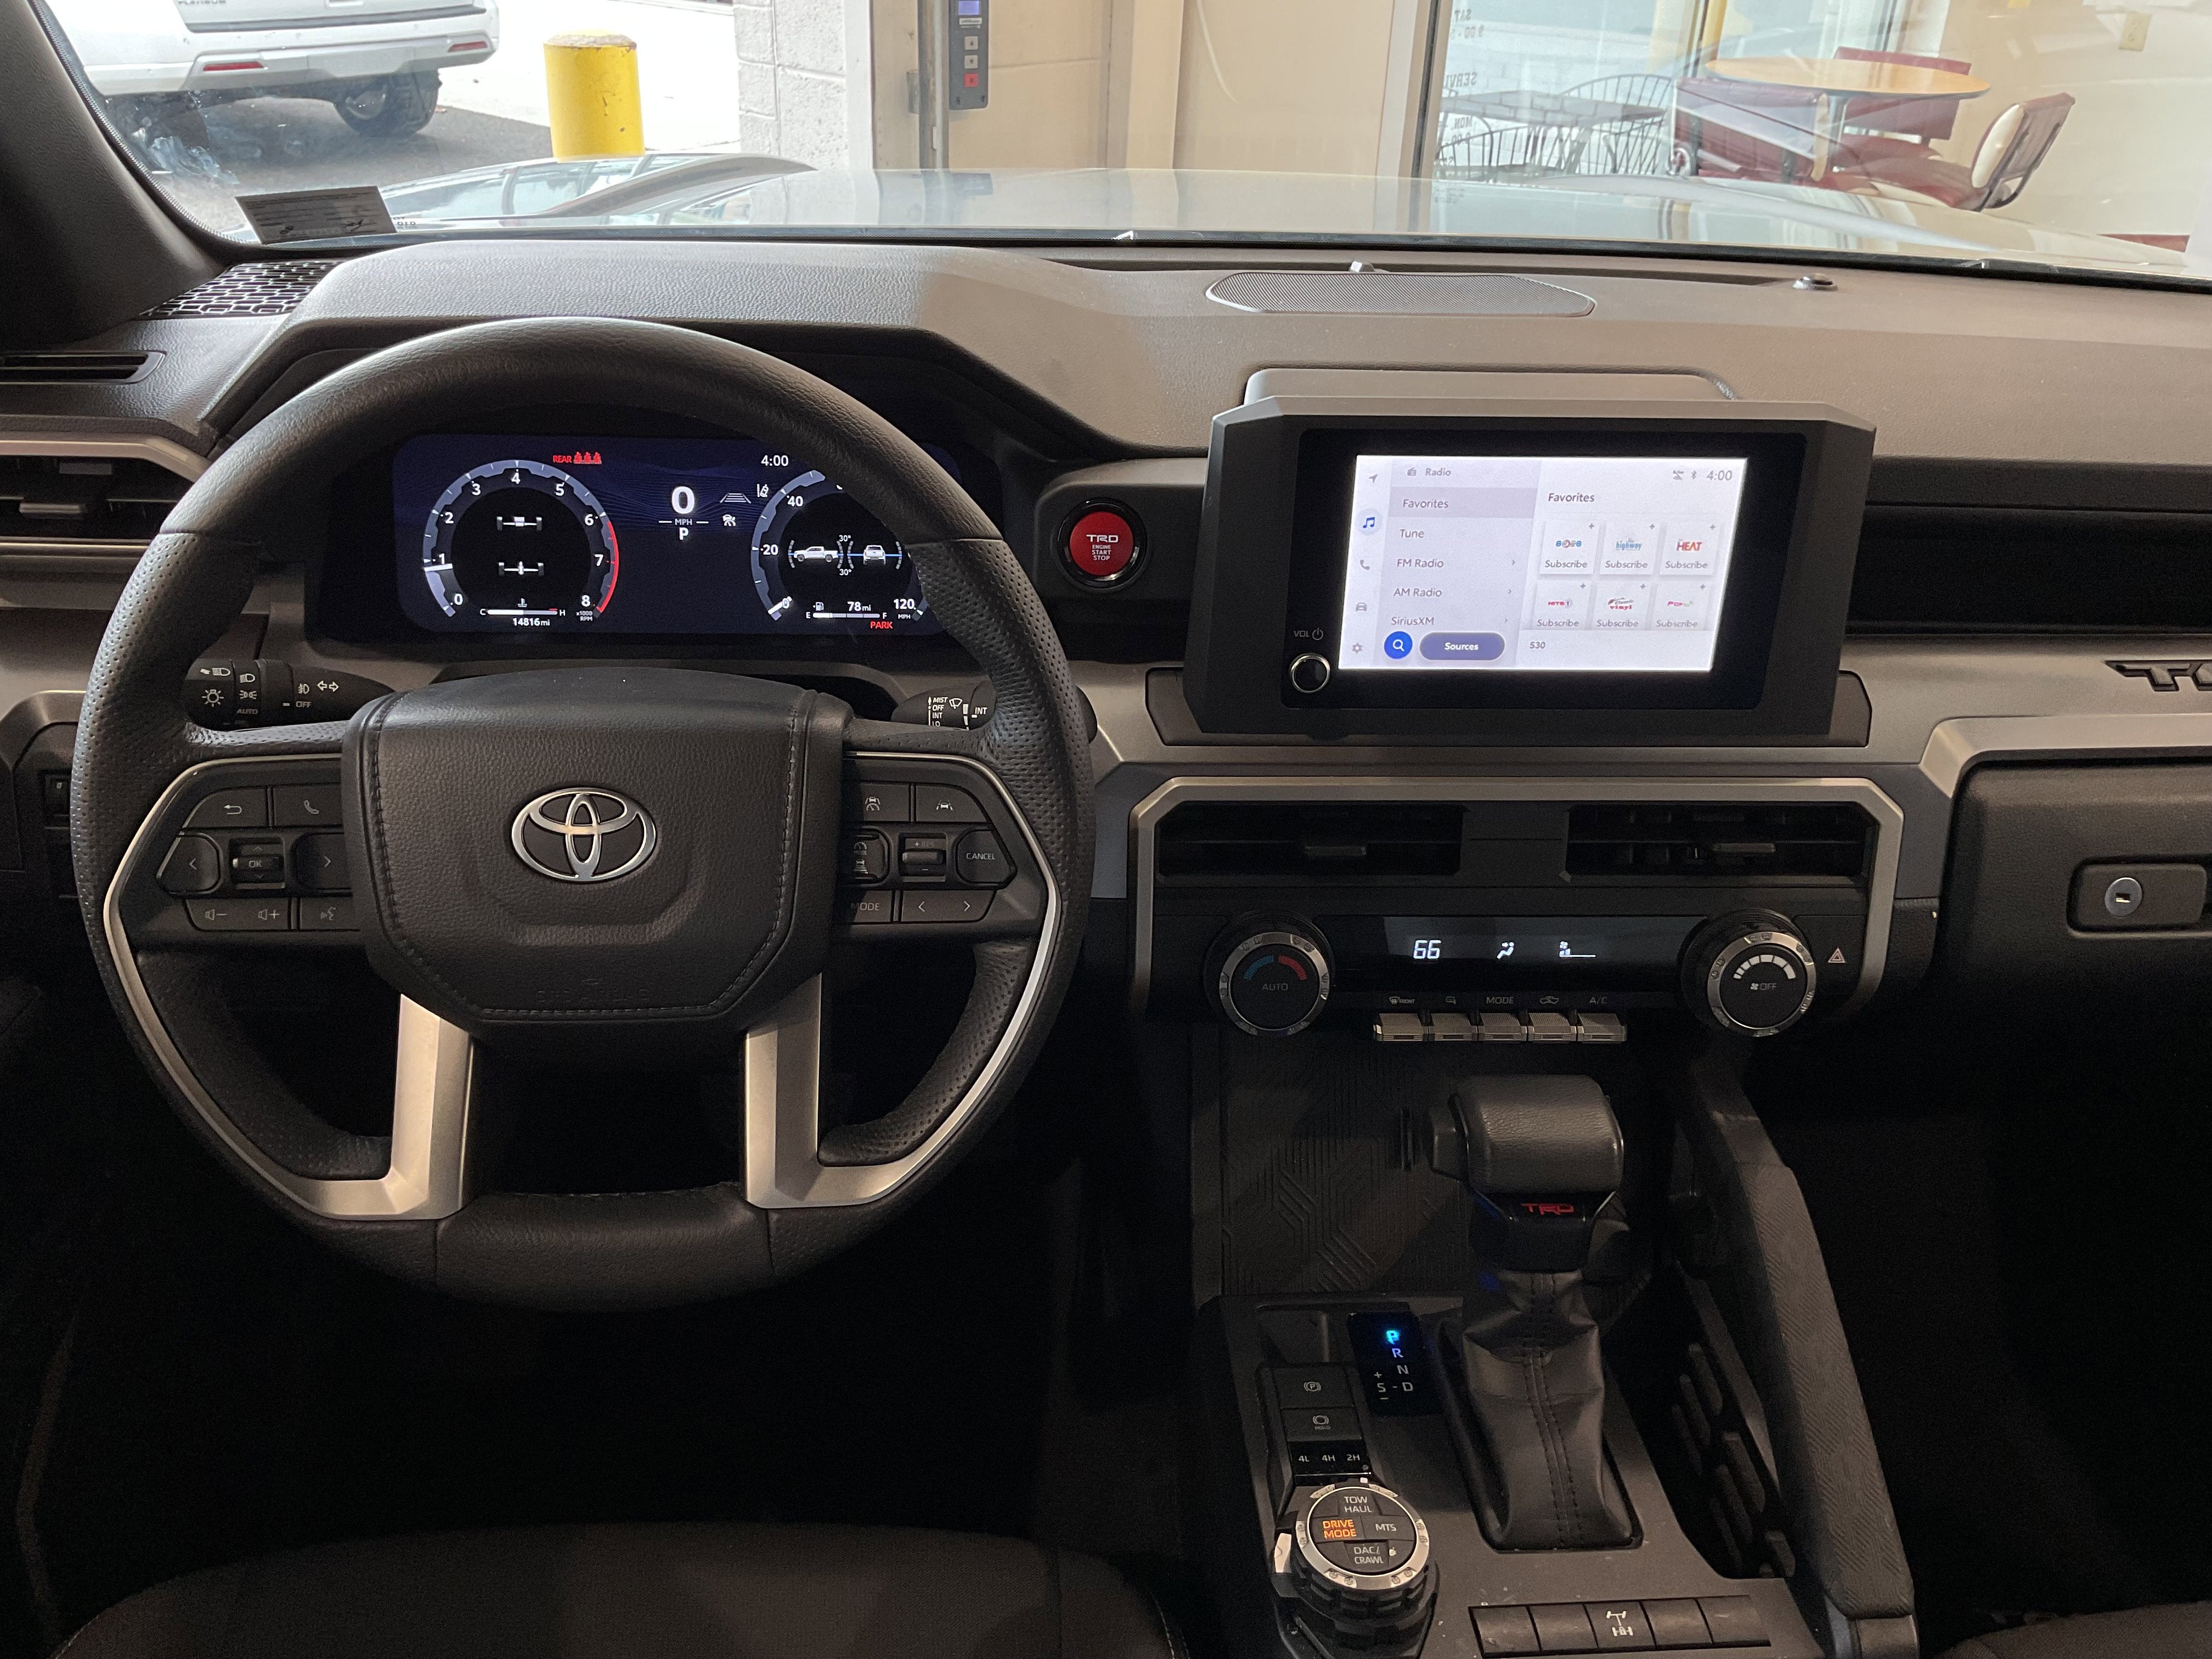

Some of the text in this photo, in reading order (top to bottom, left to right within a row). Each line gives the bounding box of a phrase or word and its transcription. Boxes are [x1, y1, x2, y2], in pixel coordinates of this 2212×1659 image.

[760, 455, 789, 467] 4:00
[1425, 467, 1452, 477] Radio
[1706, 470, 1733, 481] 4:00
[511, 472, 521, 484] 4
[472, 483, 481, 495] 3
[556, 484, 565, 496] 5
[670, 486, 696, 515] 0
[787, 495, 804, 507] 40
[1548, 493, 1595, 503] Favorites
[1402, 499, 1449, 509] Favorites
[444, 512, 454, 524] 2
[584, 514, 594, 526] 6
[679, 527, 689, 540] P
[1400, 528, 1425, 538] Tune
[838, 534, 851, 543] 30°
[1086, 534, 1119, 543] TRD
[763, 544, 778, 555] 20
[1616, 540, 1642, 551] highway
[1676, 541, 1703, 551] HEAT
[439, 553, 445, 565] 1
[594, 554, 603, 566] 7
[1397, 558, 1444, 568] FM Radio
[1544, 560, 1588, 568] Subscribe
[1605, 560, 1648, 568] Subscribe
[1665, 561, 1708, 569] Subscribe
[839, 568, 852, 576] 30°
[1393, 588, 1442, 597] AM Radio
[454, 593, 463, 605] 0
[581, 595, 591, 607] 8
[893, 599, 915, 610] 120
[870, 621, 893, 629] PARK
[1391, 616, 1435, 626] SiriusXM
[1537, 619, 1579, 628] Subscribe
[1596, 619, 1639, 628] Subscribe
[1656, 620, 1698, 628] Subscribe
[1444, 642, 1479, 651] Sources
[1529, 641, 1545, 650] 530
[975, 707, 988, 715] INT
[966, 853, 996, 861] CANCEL
[1413, 939, 1441, 960] 66
[1759, 983, 1777, 991] OFF
[1589, 996, 1607, 1005] A/C
[1520, 1202, 1574, 1215] TRD
[1386, 1329, 1400, 1344] P
[1391, 1348, 1403, 1358] R
[1397, 1364, 1409, 1375] N
[1377, 1382, 1413, 1393] S D
[1344, 1496, 1368, 1504] TOW
[1344, 1505, 1372, 1513] HAUL
[1322, 1519, 1354, 1529] DRIVE
[1375, 1523, 1397, 1532] MTS
[1323, 1528, 1357, 1539] MODE
[1353, 1545, 1380, 1555] DAC/
[1354, 1556, 1384, 1564] CRAWL
